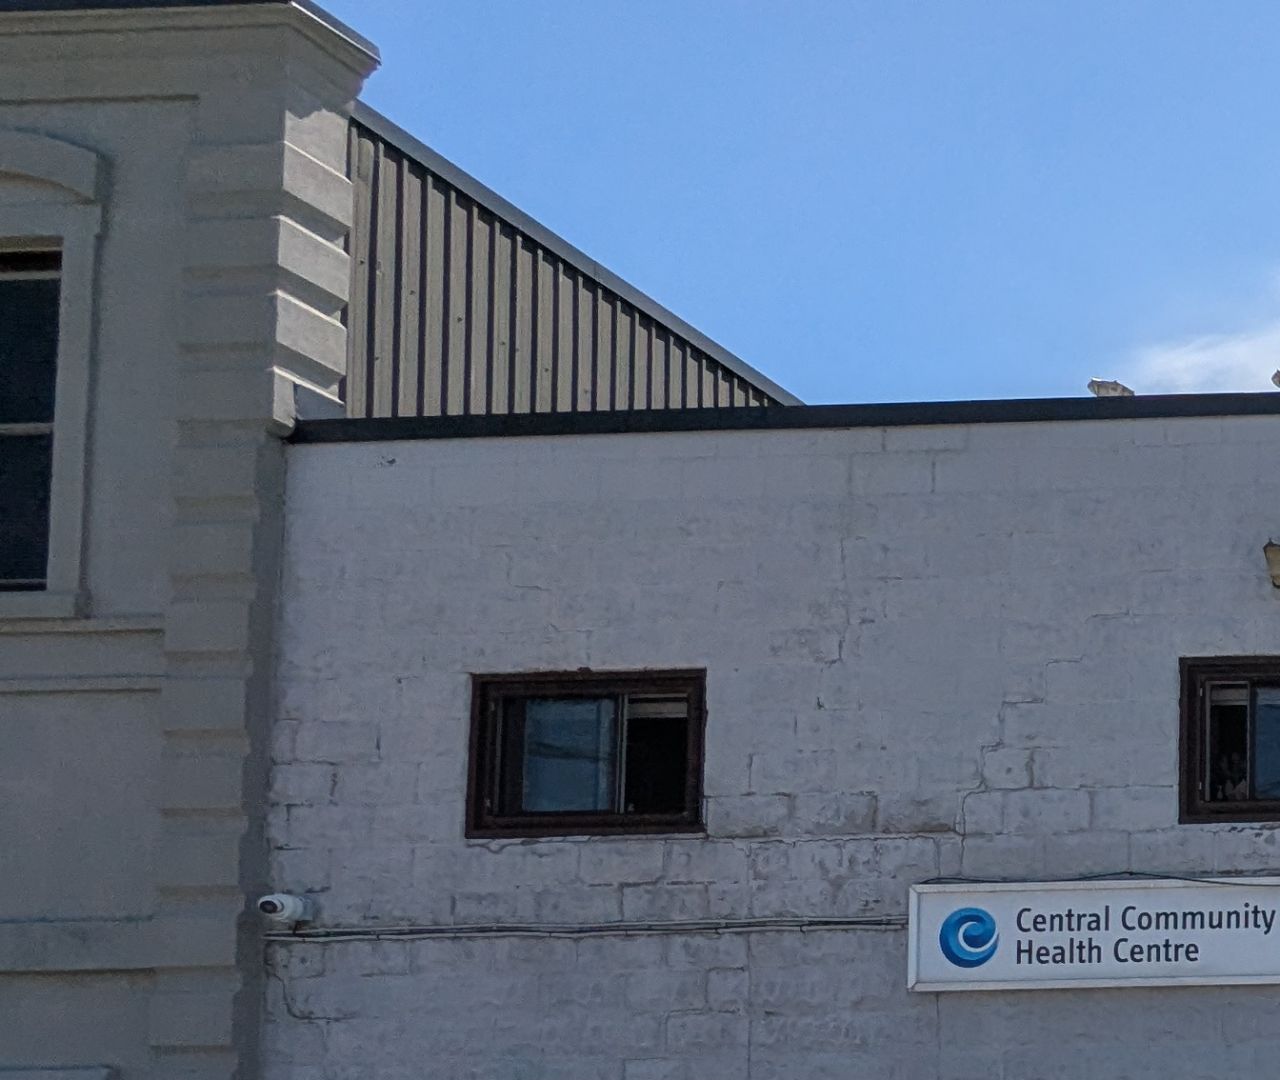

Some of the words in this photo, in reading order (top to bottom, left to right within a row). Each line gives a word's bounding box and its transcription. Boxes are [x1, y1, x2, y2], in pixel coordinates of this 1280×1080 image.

[1016, 905, 1110, 933] Central
[1121, 903, 1276, 935] Community
[1016, 938, 1102, 965] Health
[1113, 938, 1200, 963] Centre
